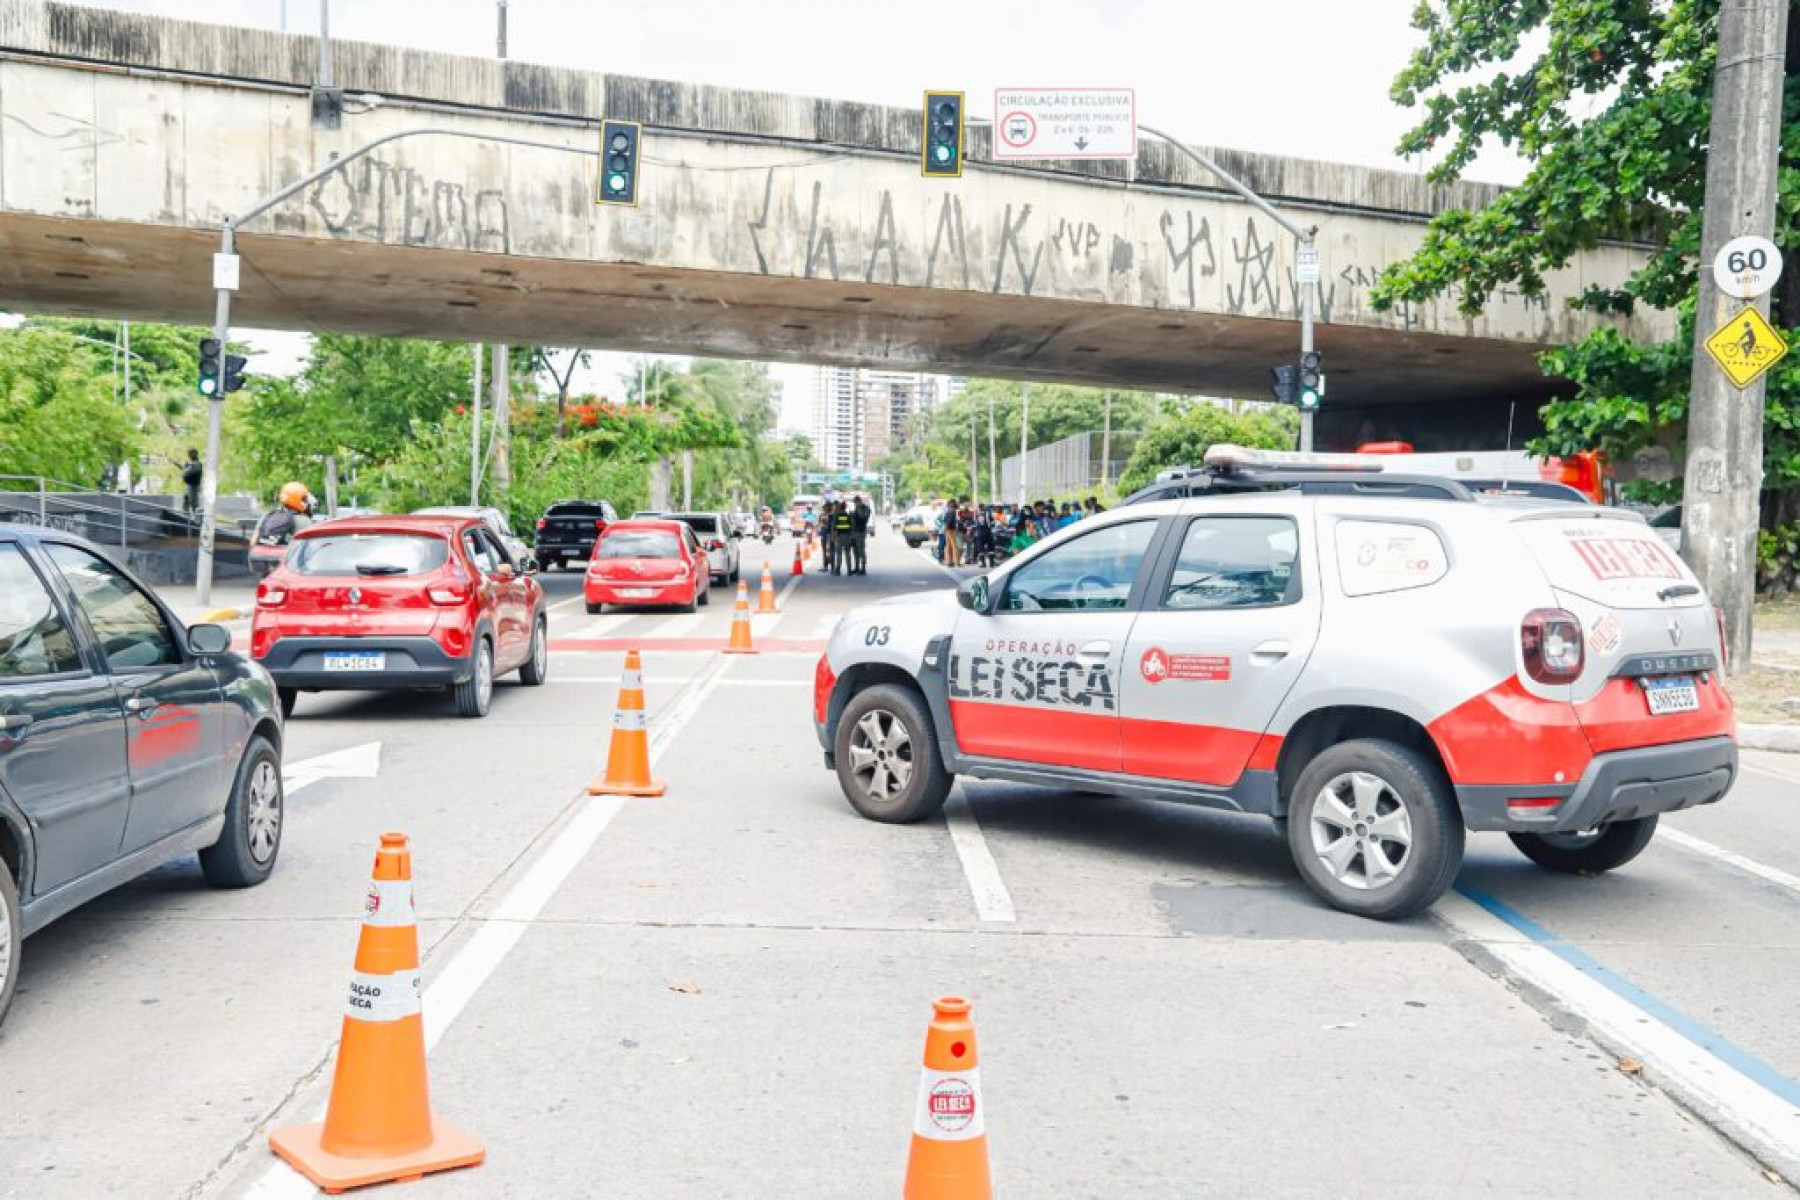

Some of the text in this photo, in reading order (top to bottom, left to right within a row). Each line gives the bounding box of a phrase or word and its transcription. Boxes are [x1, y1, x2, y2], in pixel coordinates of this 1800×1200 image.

[1000, 93, 1130, 107] CIRCULAÇÃO EXCLUSIVA
[1038, 113, 1091, 122] TRANSPORTE
[1727, 248, 1767, 273] 60
[864, 625, 892, 646] 03
[985, 637, 1077, 656] OPERAÇÃO
[949, 654, 1115, 710] LEI SECA
